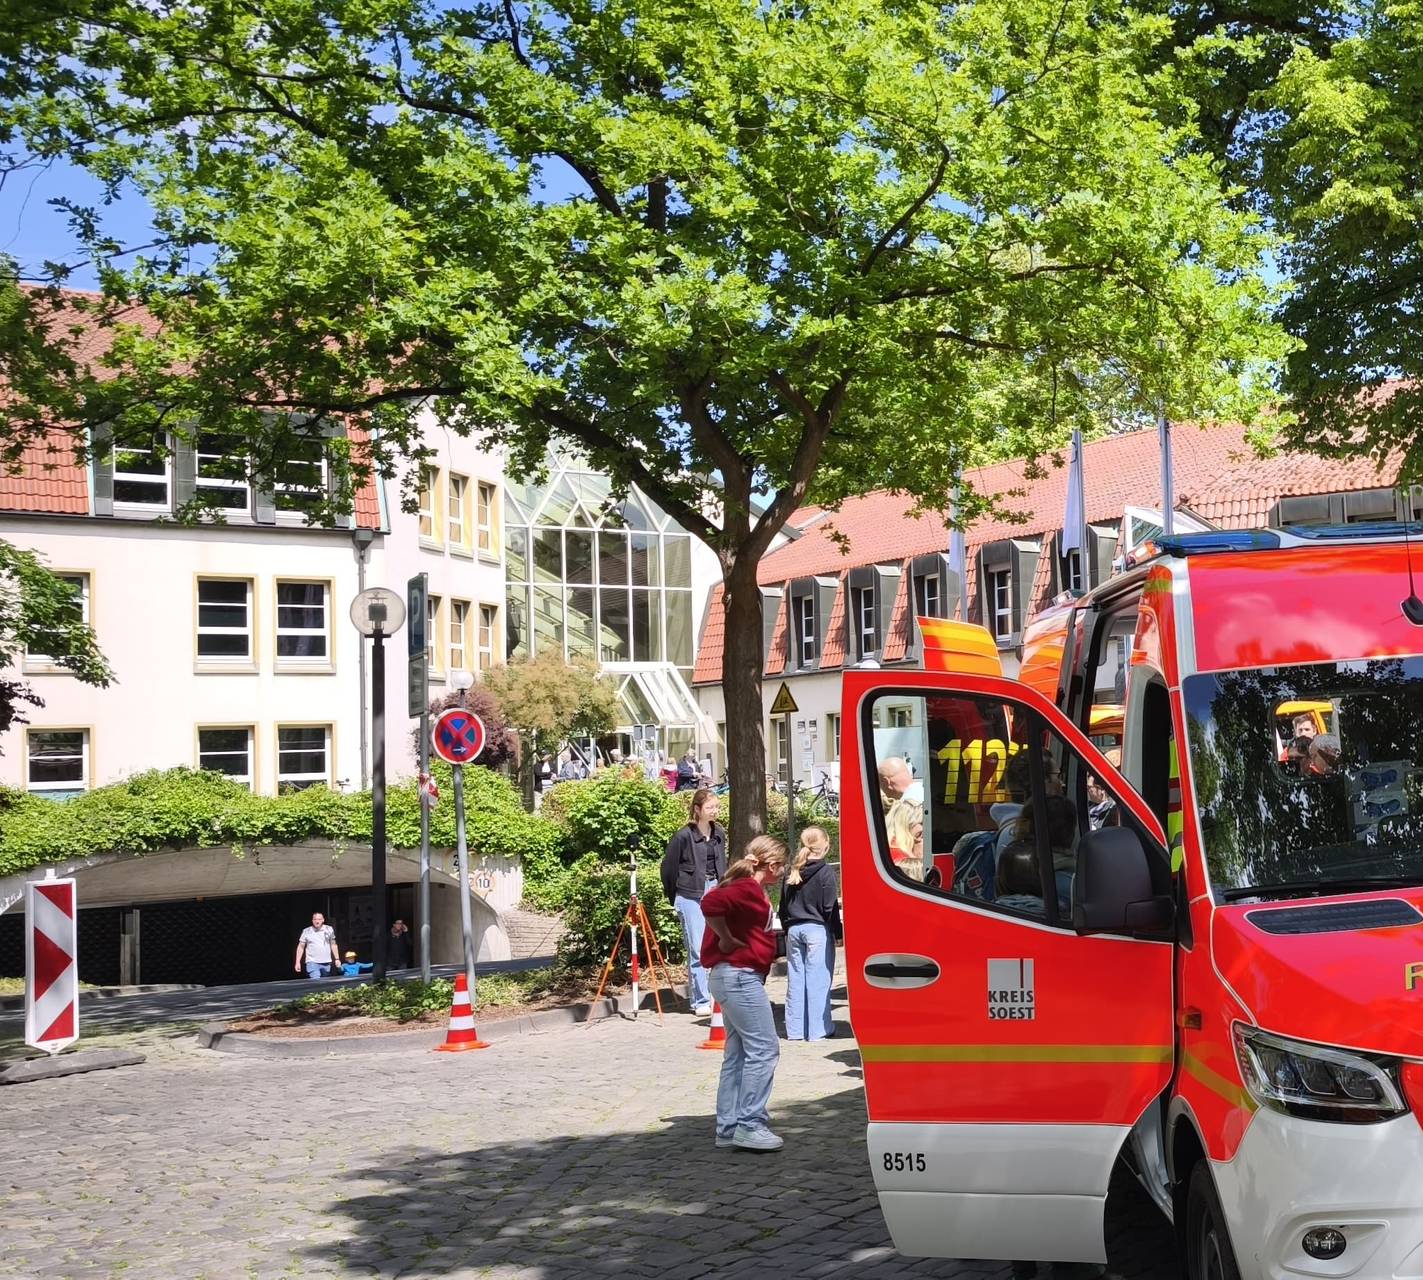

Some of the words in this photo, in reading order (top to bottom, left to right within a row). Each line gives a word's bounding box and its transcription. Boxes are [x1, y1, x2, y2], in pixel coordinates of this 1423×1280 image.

[937, 739, 1009, 804] 112
[988, 991, 1033, 1003] KREIS
[989, 1007, 1034, 1019] SOEST
[883, 1152, 926, 1172] 8515
